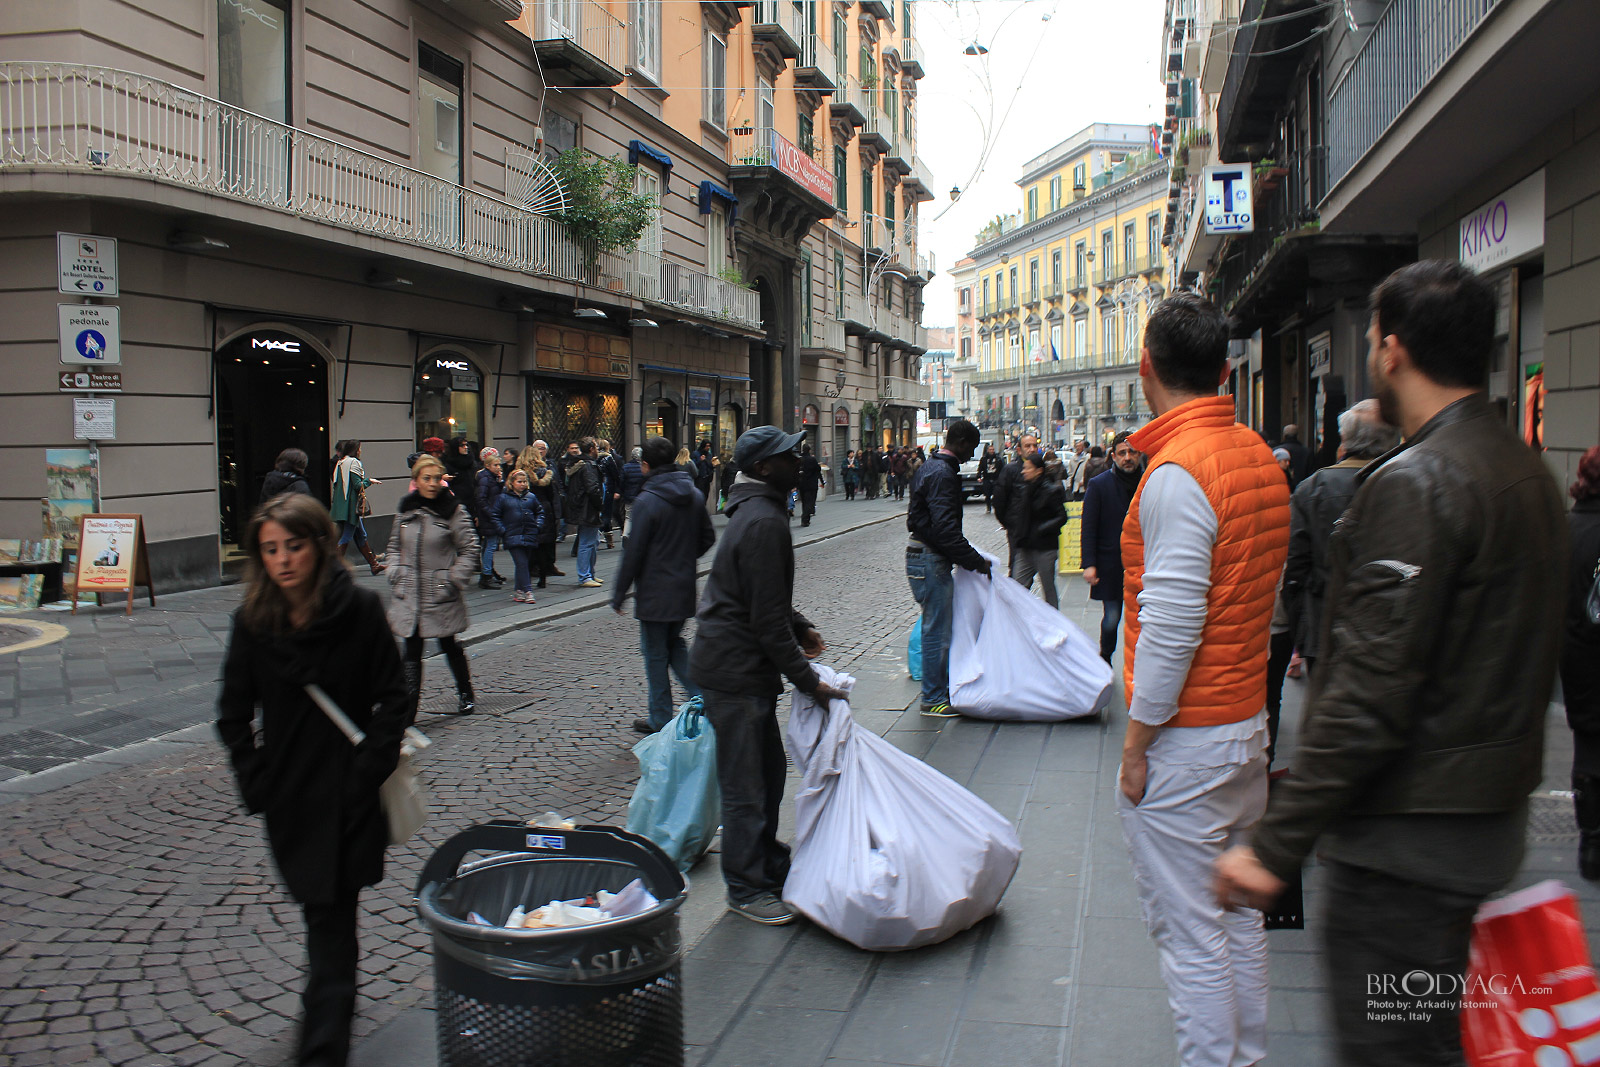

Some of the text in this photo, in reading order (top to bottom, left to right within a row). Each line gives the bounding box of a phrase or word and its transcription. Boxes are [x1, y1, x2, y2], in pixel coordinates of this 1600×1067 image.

[1212, 171, 1243, 213] T
[1206, 213, 1251, 226] LOTTO
[1462, 200, 1508, 262] KIKO
[72, 264, 105, 273] HOTEL
[69, 318, 110, 326] pedonale
[251, 338, 300, 352] MAC
[436, 360, 469, 371] MAC
